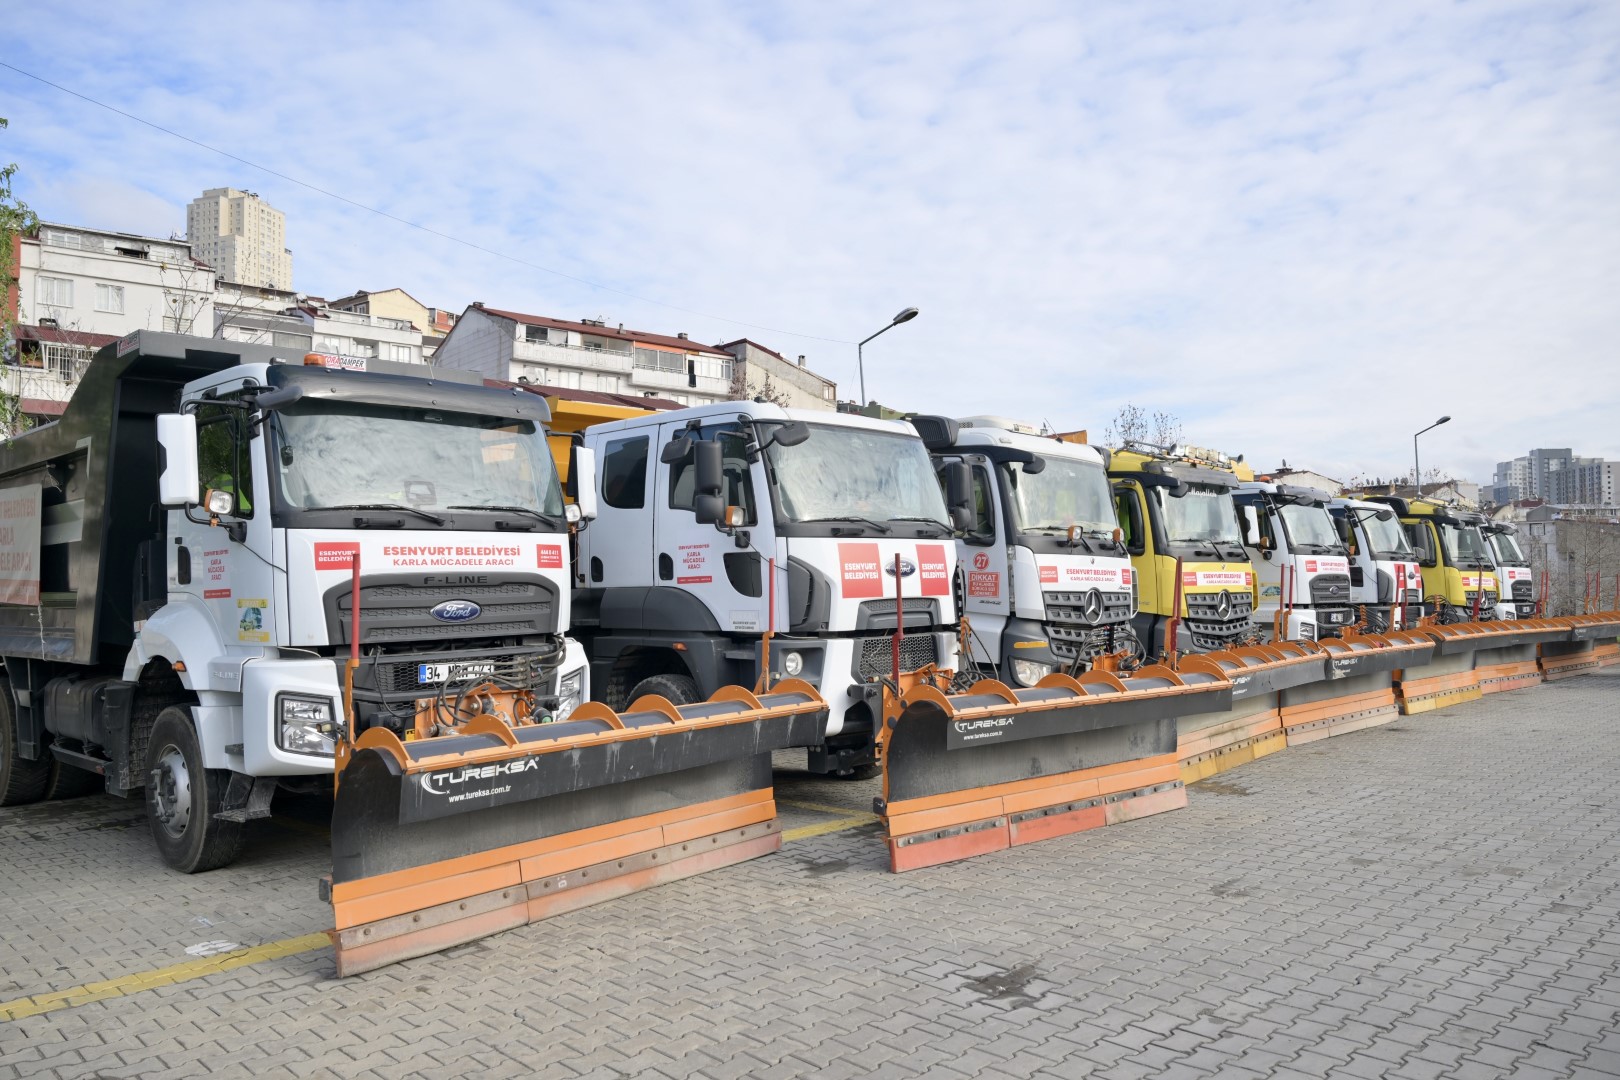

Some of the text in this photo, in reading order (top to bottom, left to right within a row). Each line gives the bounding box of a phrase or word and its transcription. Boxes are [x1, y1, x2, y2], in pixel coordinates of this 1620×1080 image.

[383, 545, 521, 556] ESENYURT BELEDİYESİ
[393, 557, 513, 566] KARLA MÜCADELE ARACI
[844, 562, 877, 571] ESENYURT
[976, 556, 987, 568] 27
[423, 576, 488, 585] F-LINE
[844, 570, 878, 580] BELEDİYESİ
[443, 604, 471, 618] Ford
[427, 666, 440, 680] 34
[959, 717, 1014, 731] TUREKSA
[432, 758, 539, 786] TUREKSA
[448, 784, 511, 803] www.tureksa.com.tr
